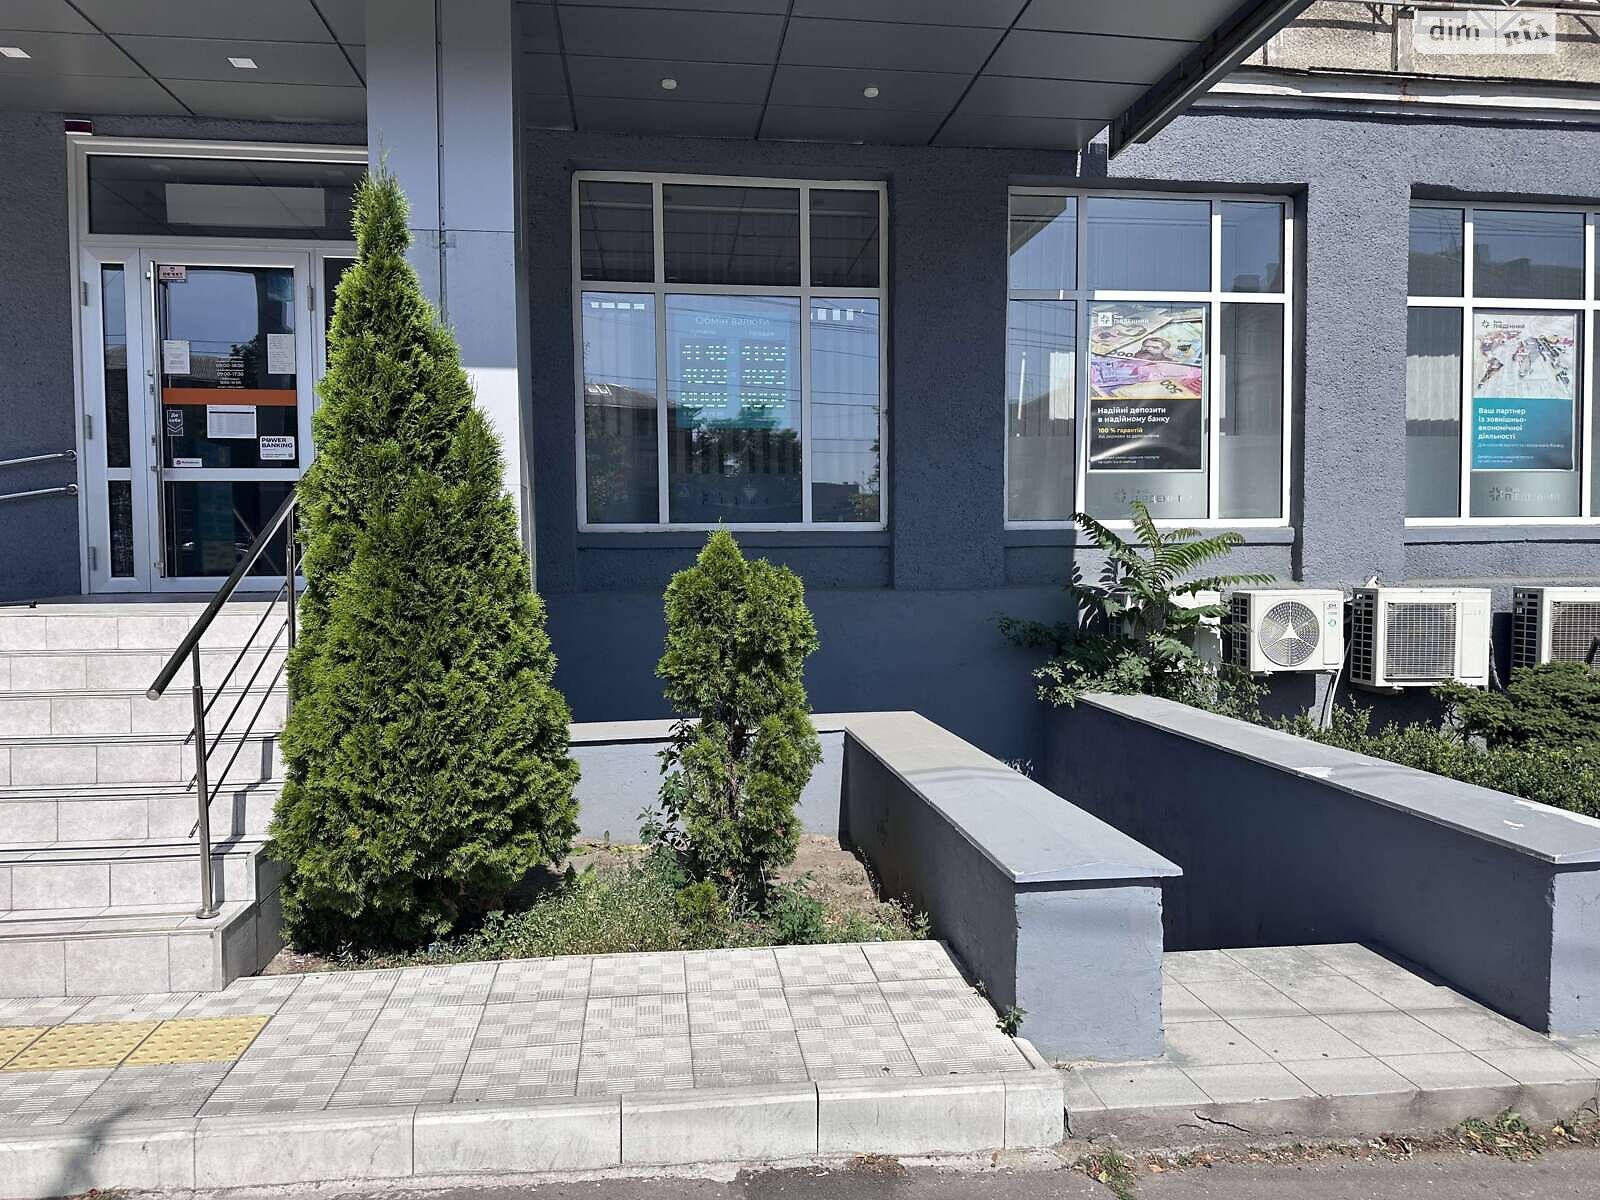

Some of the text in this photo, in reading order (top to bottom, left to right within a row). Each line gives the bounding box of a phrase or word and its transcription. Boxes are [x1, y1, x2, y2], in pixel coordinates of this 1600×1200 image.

[1097, 406, 1166, 415] Надійні депозити
[1495, 408, 1526, 416] партнер
[1104, 414, 1146, 424] надійному
[1147, 414, 1170, 424] банку
[1117, 426, 1143, 434] гарантій
